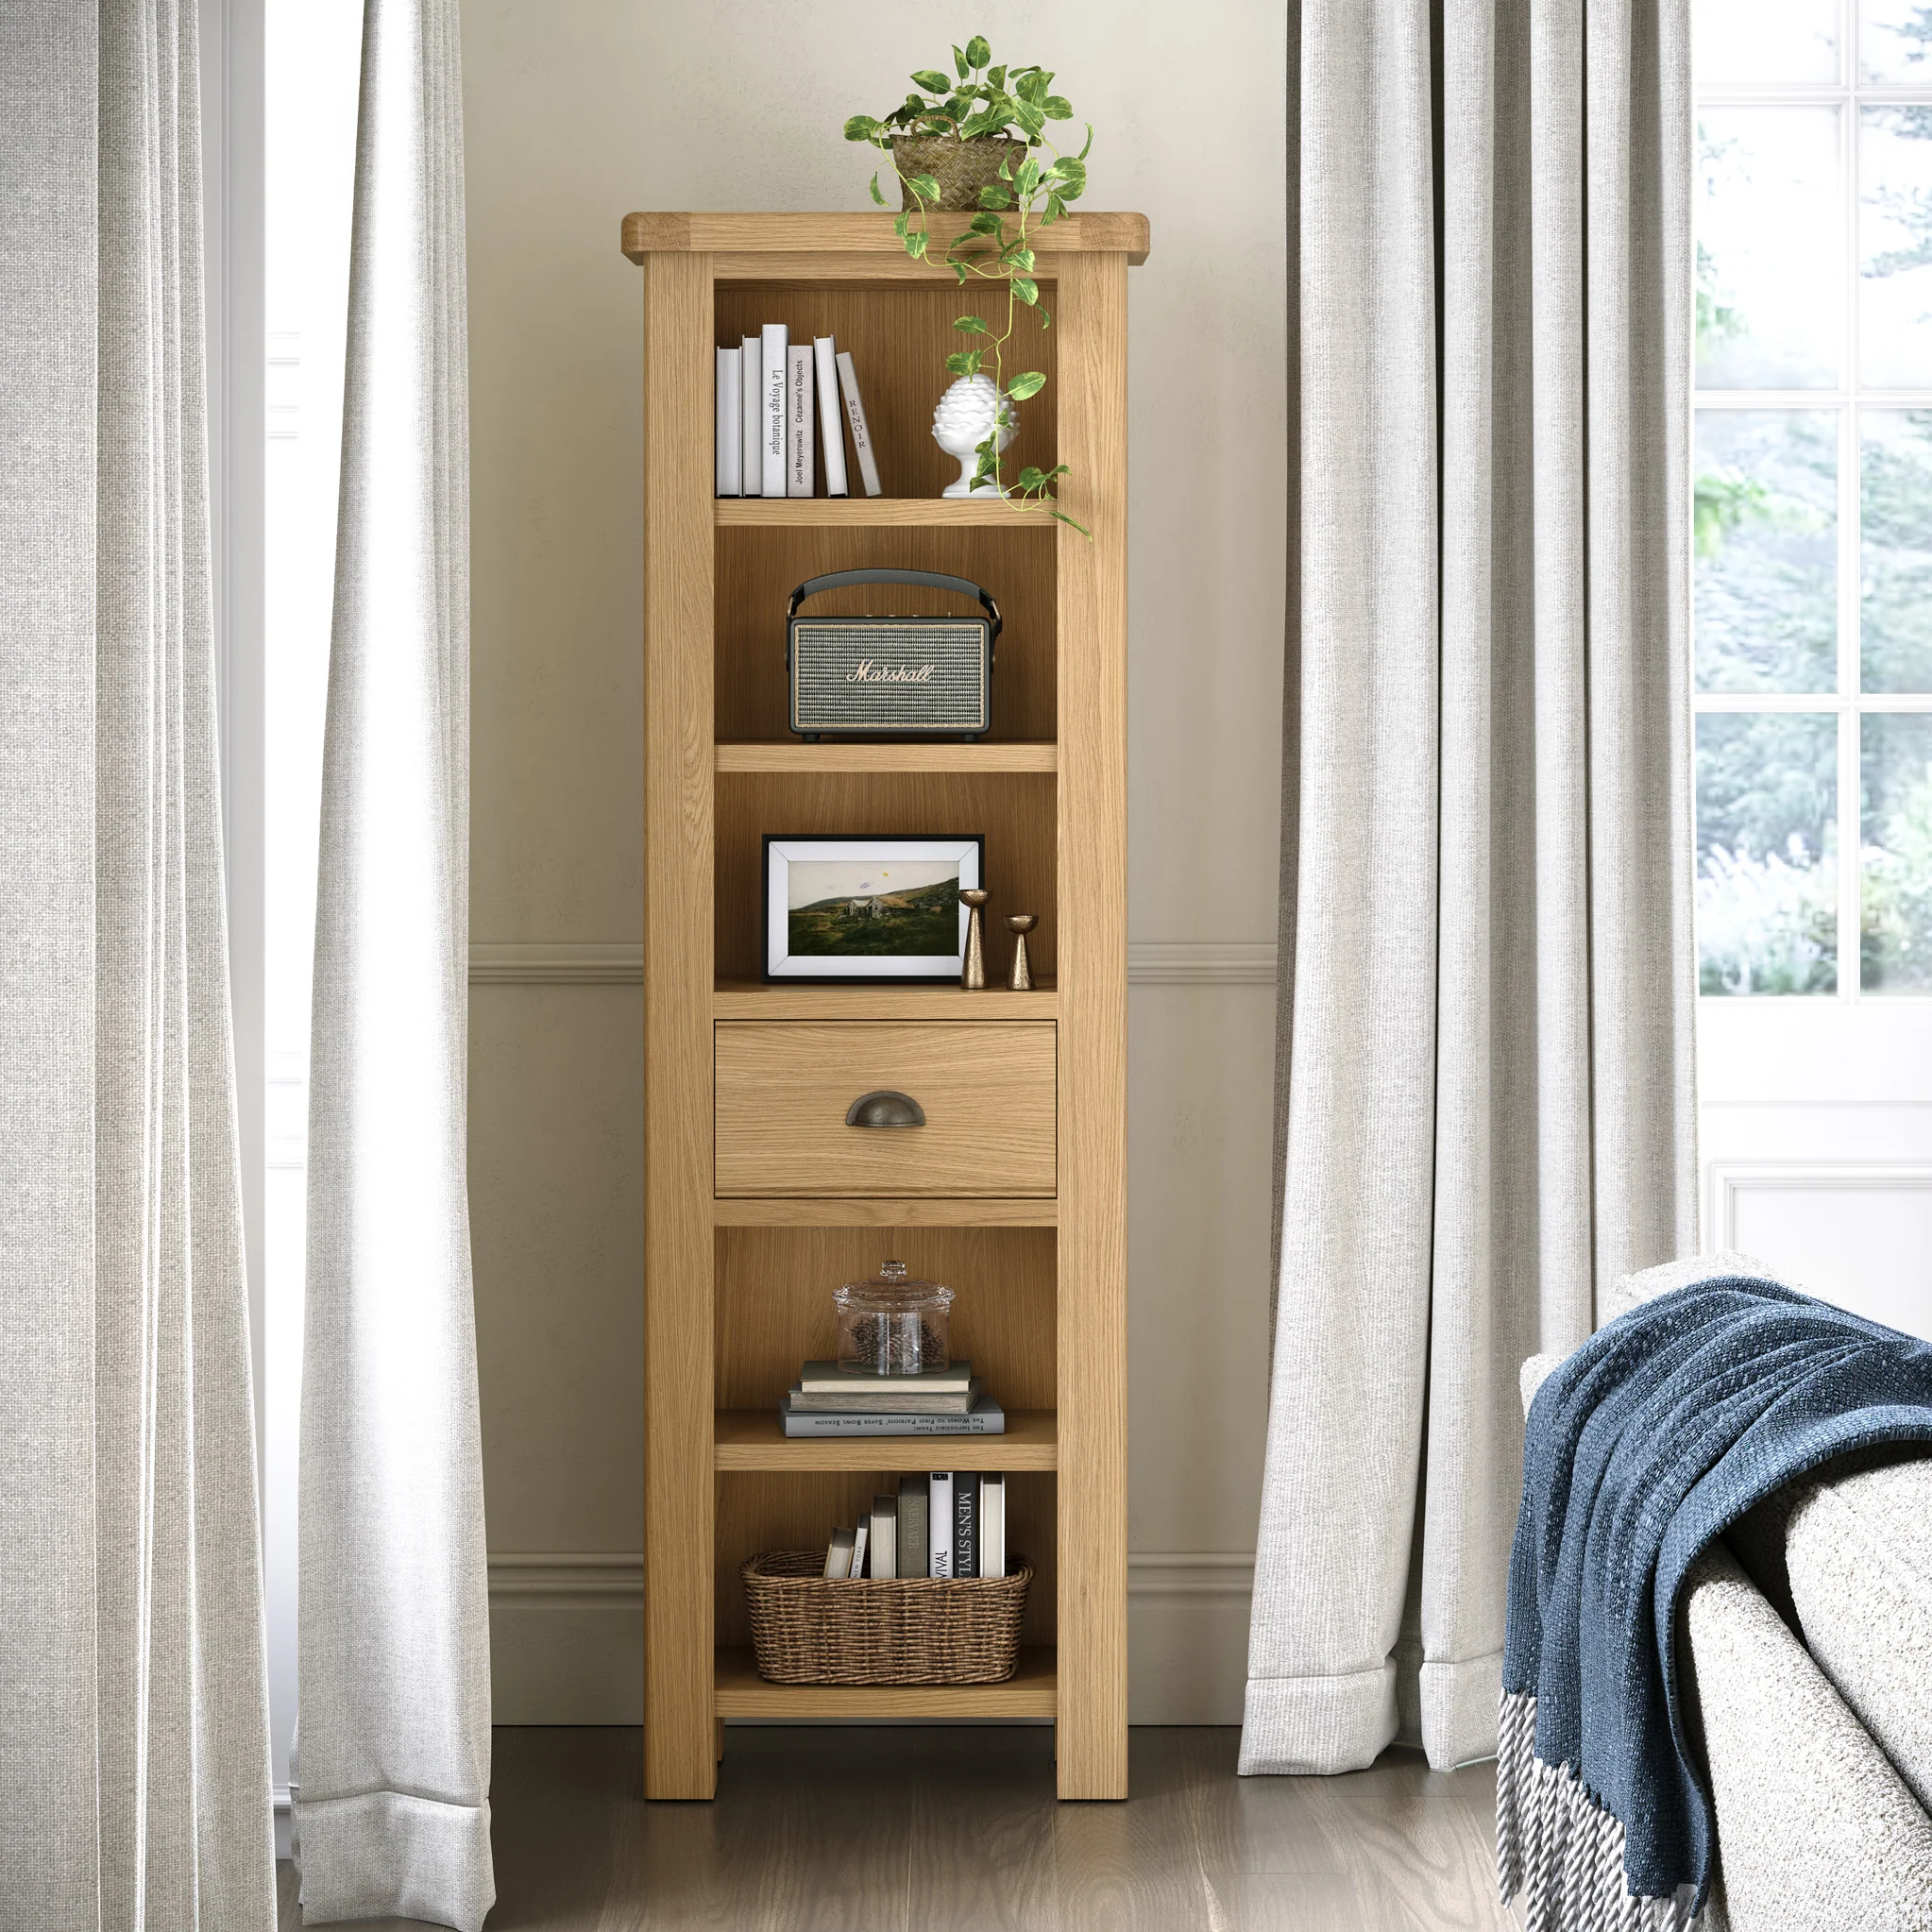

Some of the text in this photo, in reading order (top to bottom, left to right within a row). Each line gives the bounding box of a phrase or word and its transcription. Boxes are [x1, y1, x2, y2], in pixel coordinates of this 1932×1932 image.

[795, 360, 805, 387] Objects
[769, 369, 783, 455] Le Voyage botanique
[849, 399, 866, 449] RENOIR
[795, 430, 805, 468] Meyerowitz
[846, 659, 935, 682] Marshall
[958, 1492, 972, 1579] MEN'S STYL
